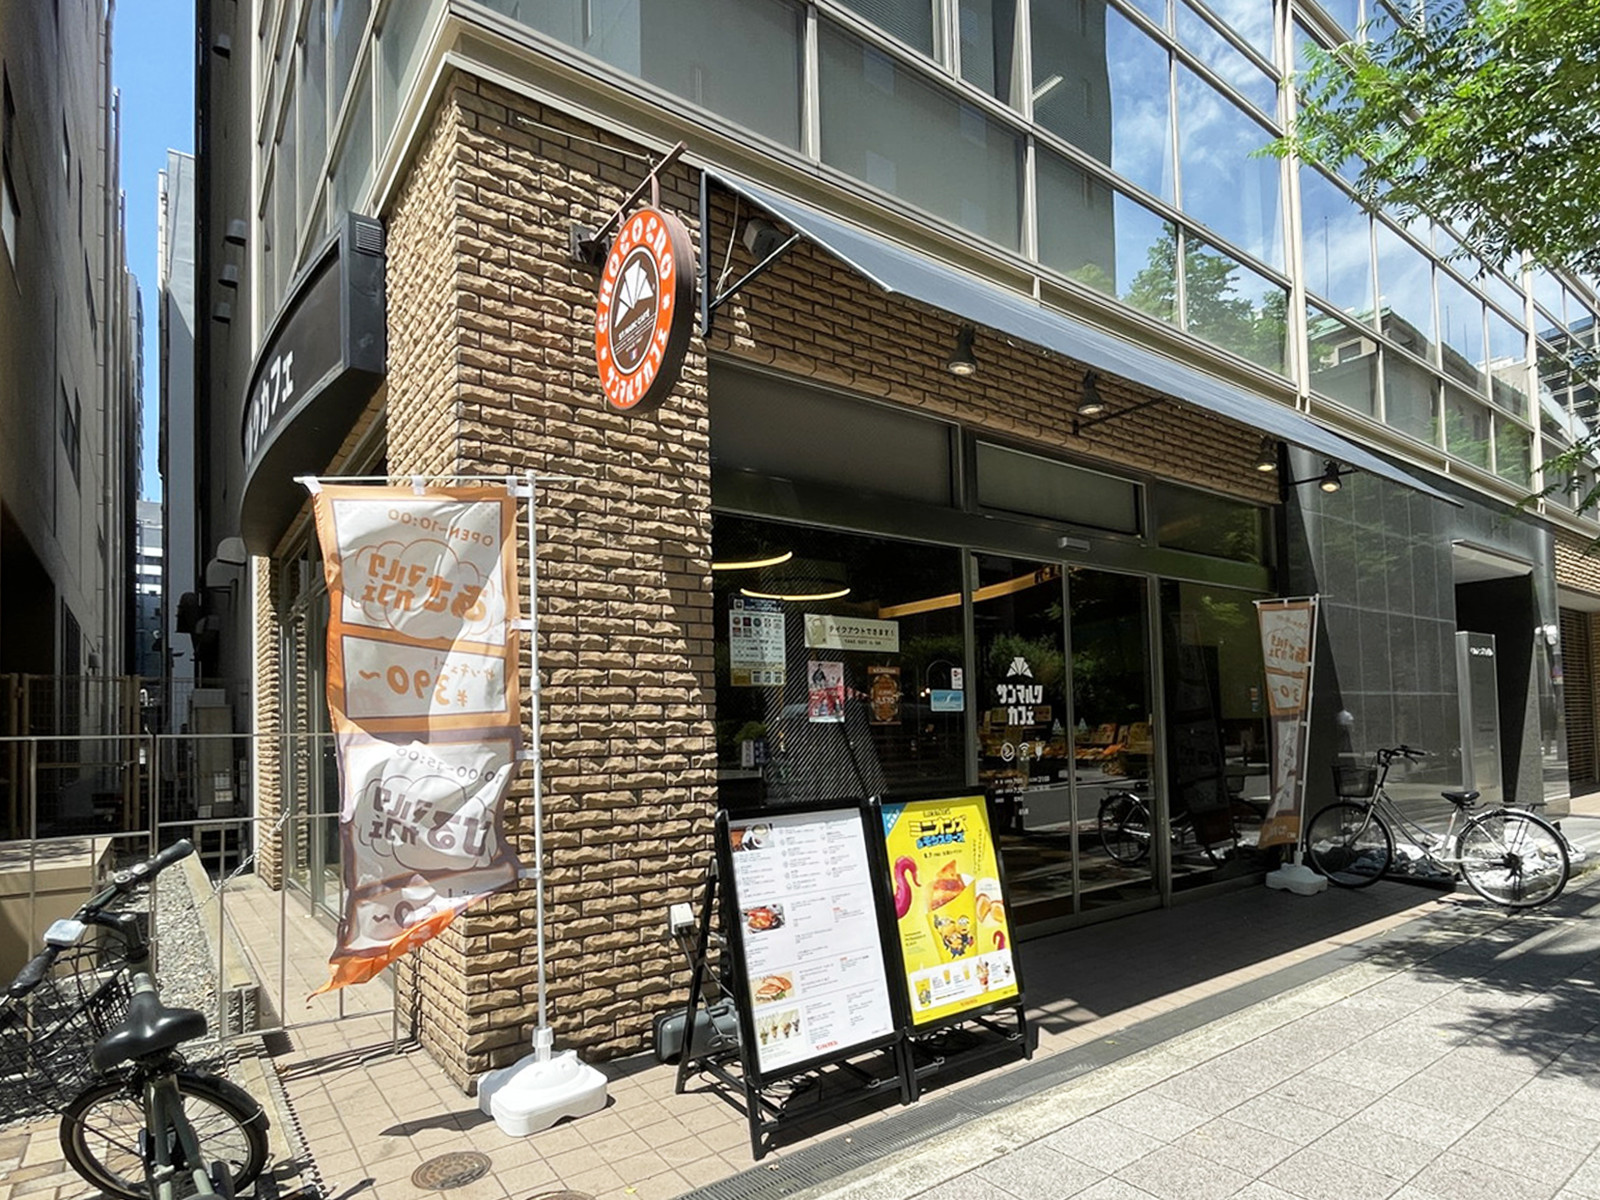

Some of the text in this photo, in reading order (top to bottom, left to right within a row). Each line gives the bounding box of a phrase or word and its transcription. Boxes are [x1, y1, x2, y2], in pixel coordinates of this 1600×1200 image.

[996, 684, 1043, 704] サンマルク
[1007, 705, 1035, 725] カフェ
